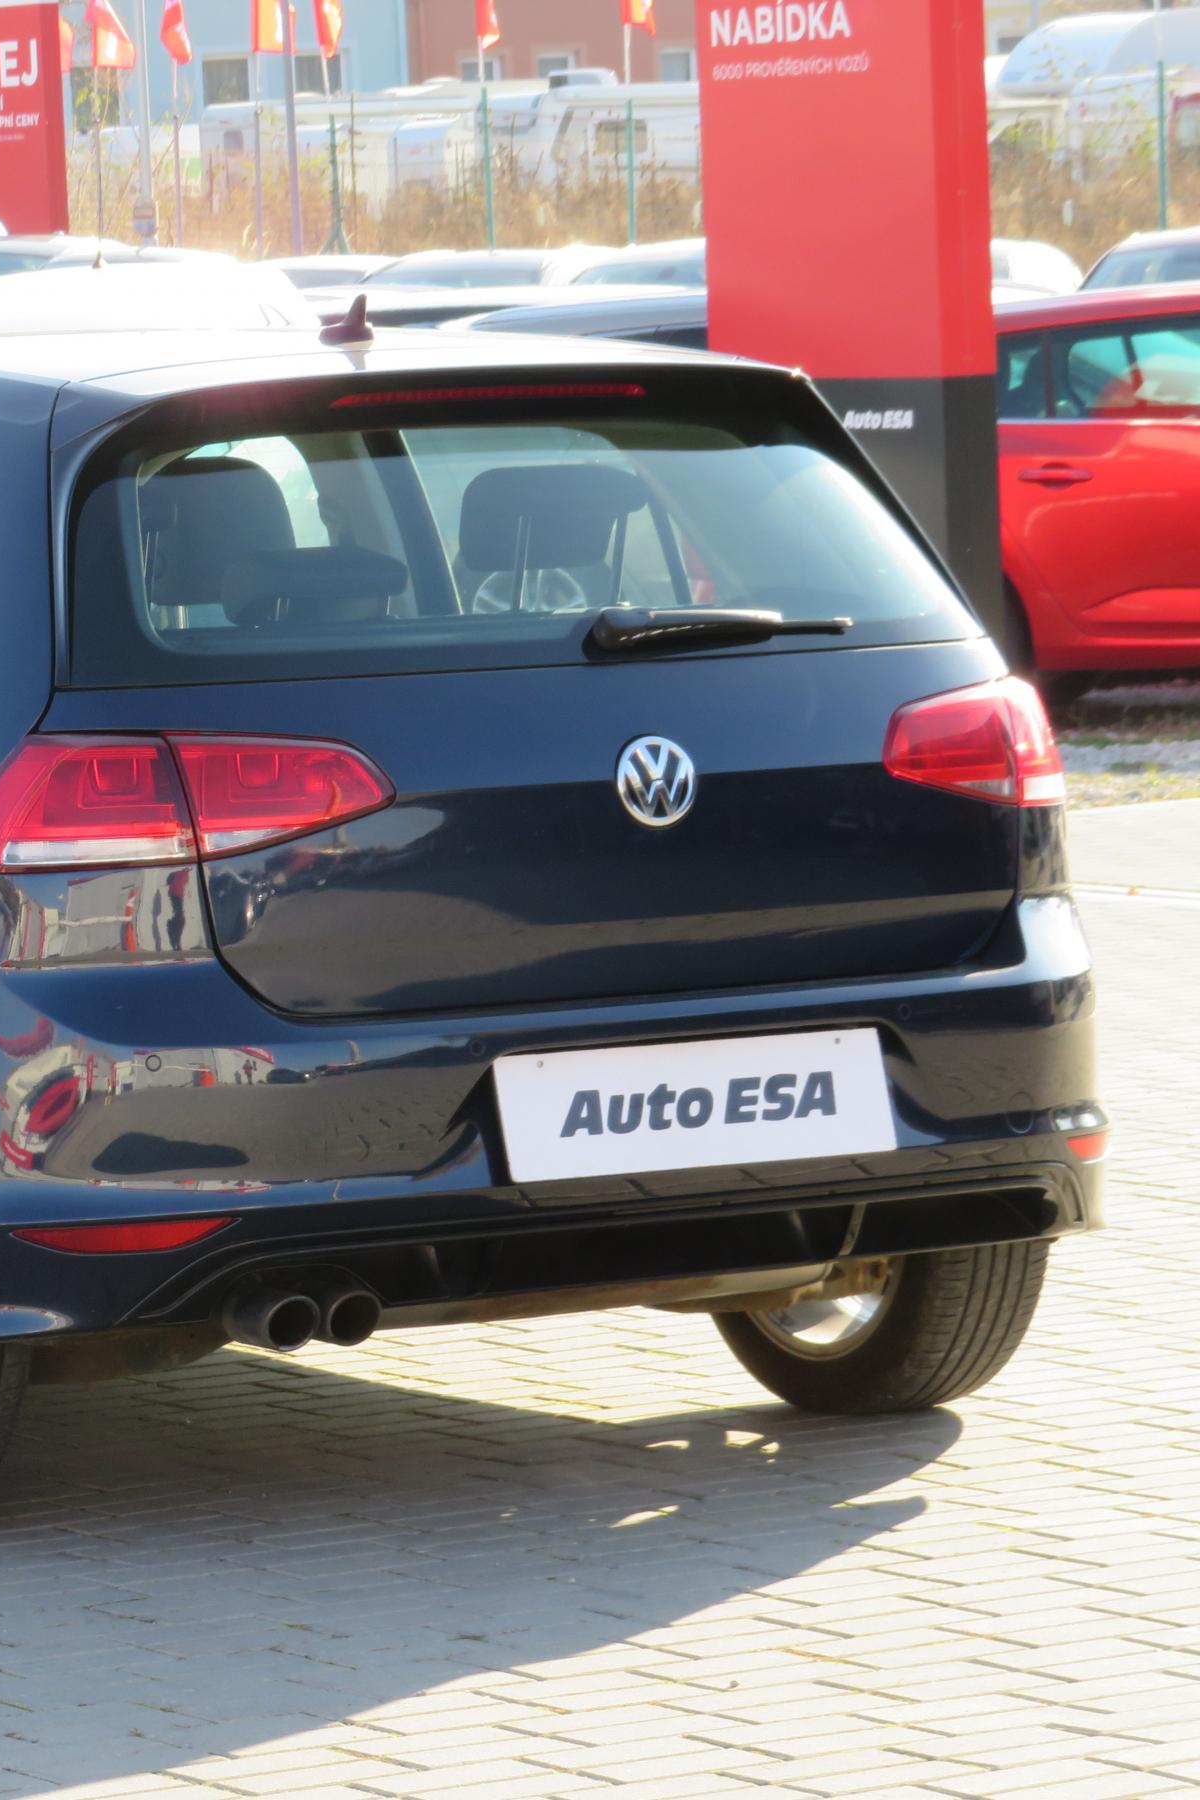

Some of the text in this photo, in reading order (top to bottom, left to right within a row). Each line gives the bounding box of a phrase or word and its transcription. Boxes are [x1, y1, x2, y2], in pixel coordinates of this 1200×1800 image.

[710, 0, 852, 47] NABÍDKA
[15, 112, 40, 128] CENY
[842, 409, 914, 430] Auto ESA
[560, 1071, 837, 1138] Auto ESA
